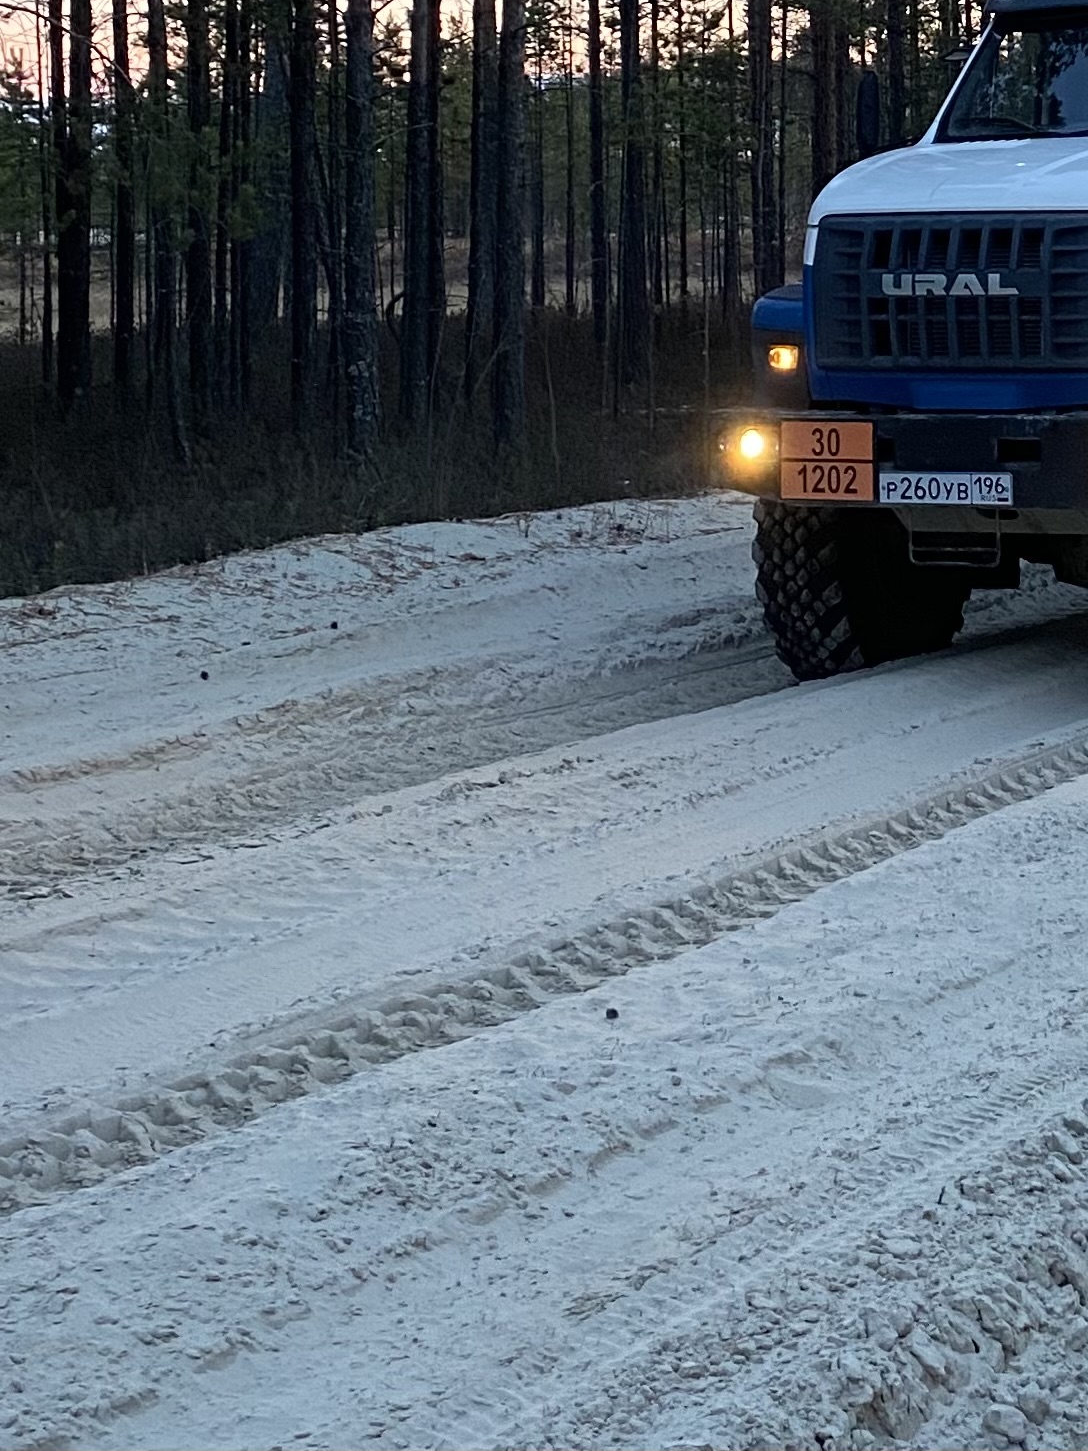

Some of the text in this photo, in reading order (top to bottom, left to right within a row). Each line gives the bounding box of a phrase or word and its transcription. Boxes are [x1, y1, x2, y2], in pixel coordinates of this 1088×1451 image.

[882, 273, 1020, 296] URAL
[811, 428, 841, 457] 30
[797, 465, 858, 494] 1202
[974, 477, 1005, 494] 196
